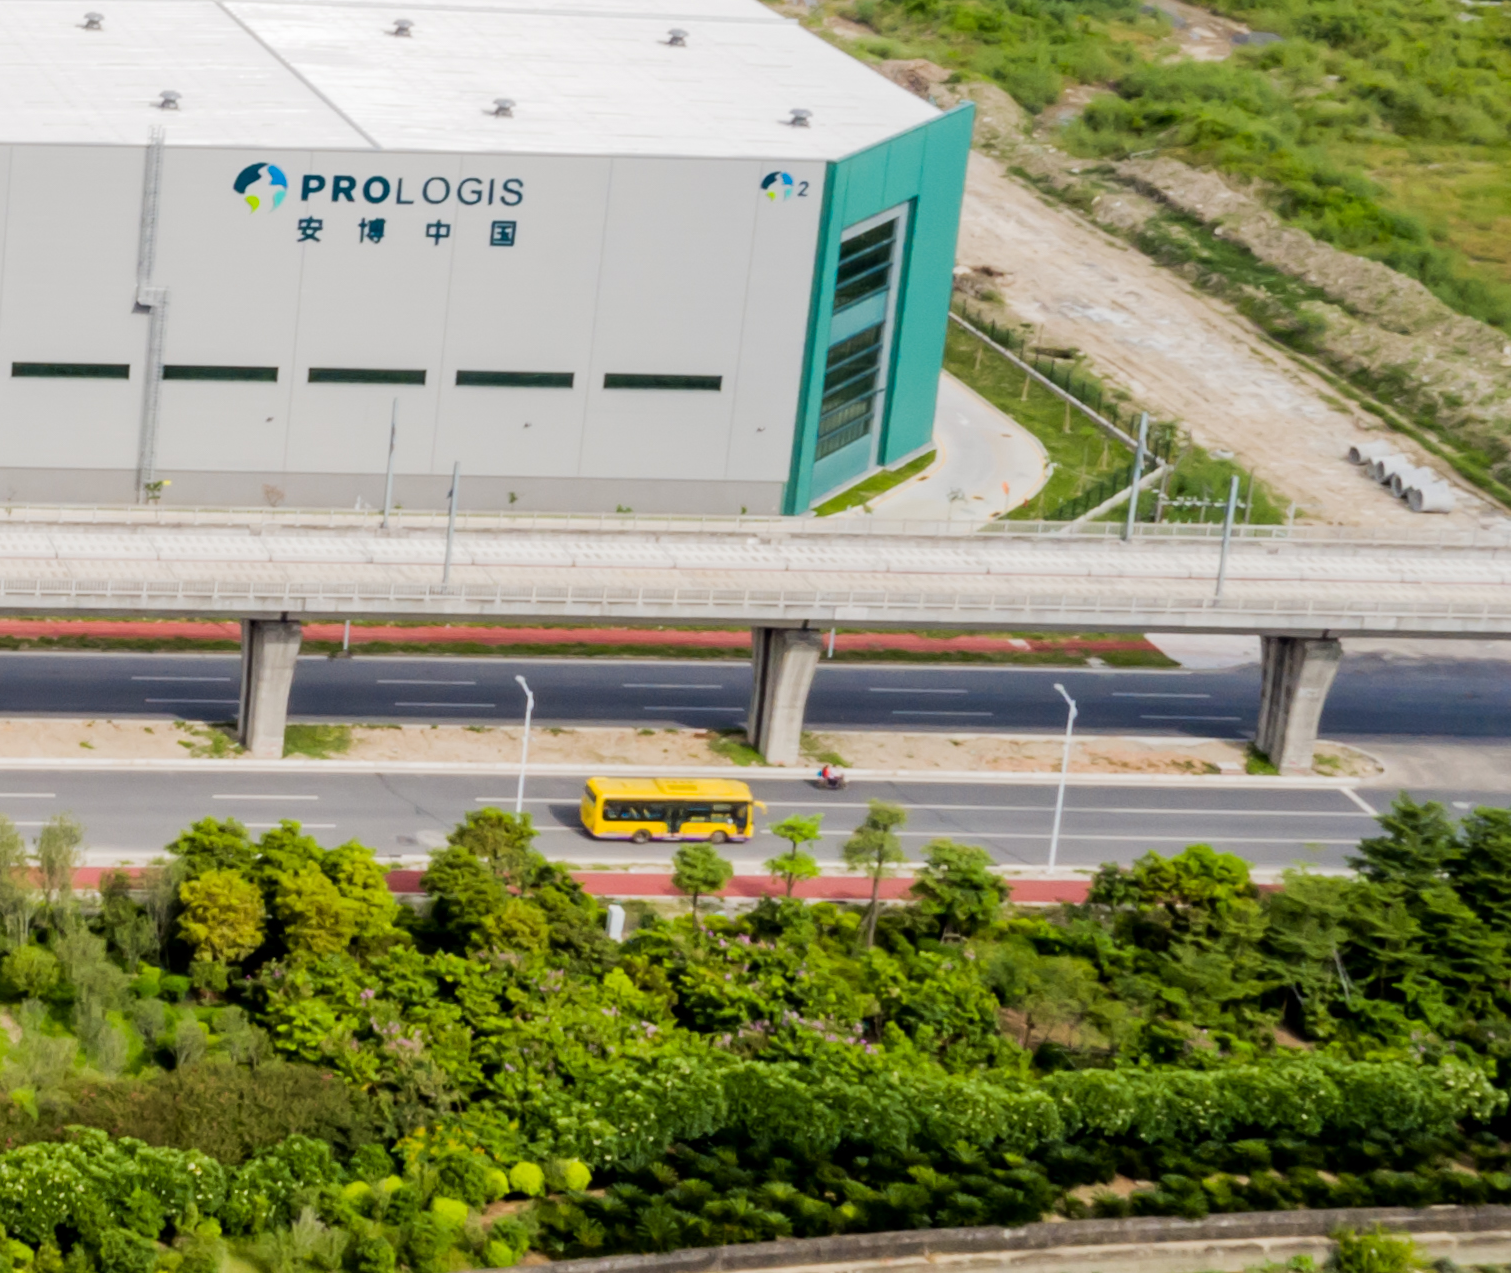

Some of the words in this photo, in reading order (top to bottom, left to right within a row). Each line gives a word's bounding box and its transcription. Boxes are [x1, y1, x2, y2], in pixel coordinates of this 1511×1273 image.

[300, 174, 524, 207] PROLOGIS
[796, 180, 810, 198] 2
[296, 215, 518, 248] 安博中国
